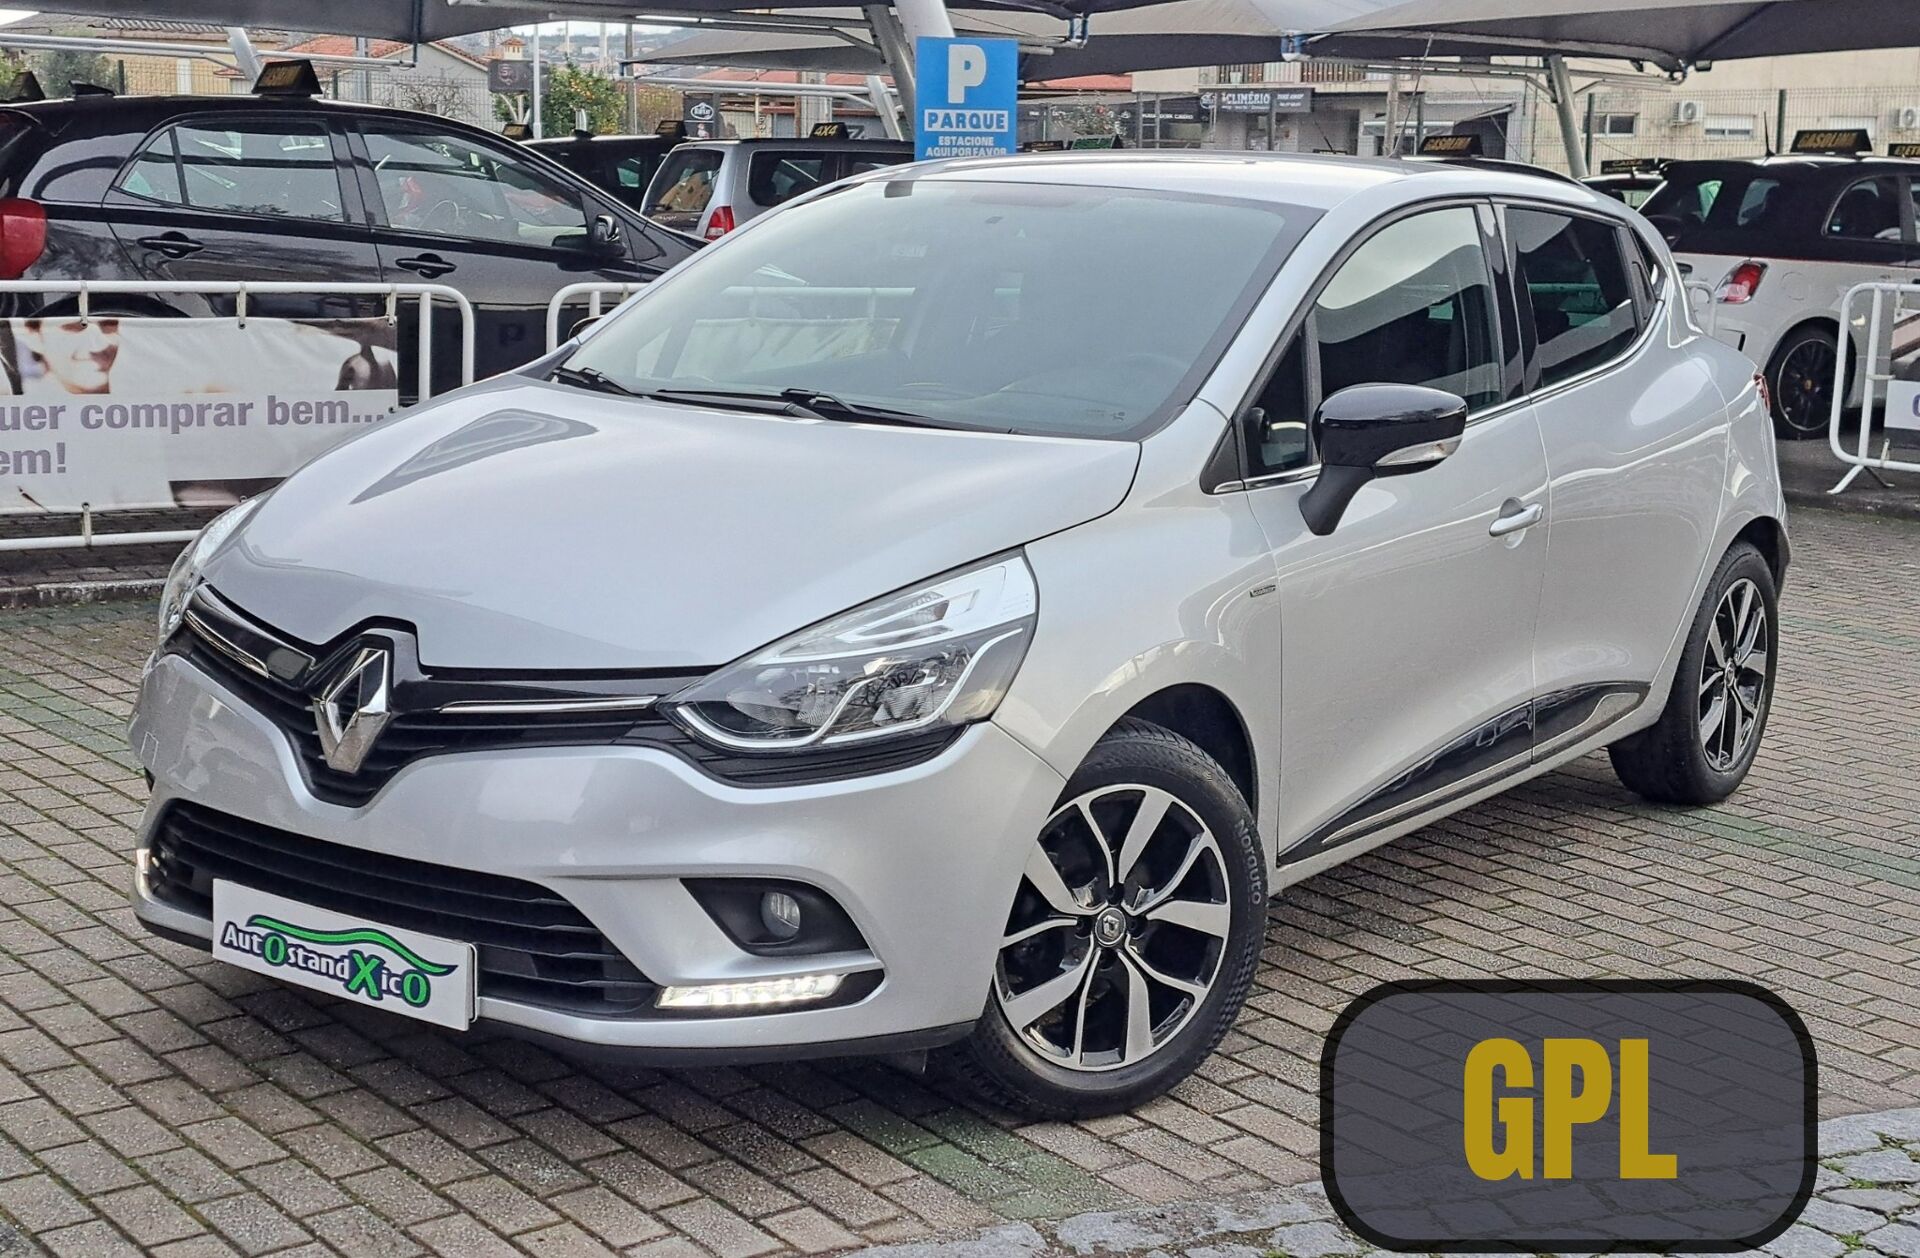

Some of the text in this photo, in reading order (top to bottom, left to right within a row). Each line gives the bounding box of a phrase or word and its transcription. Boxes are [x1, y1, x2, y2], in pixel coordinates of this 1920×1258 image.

[948, 44, 987, 104] P
[927, 112, 1005, 129] PARQUE
[814, 125, 838, 137] 4X4
[938, 136, 994, 146] ESTACIONE
[80, 402, 254, 434] comprar
[267, 395, 384, 425] bem...
